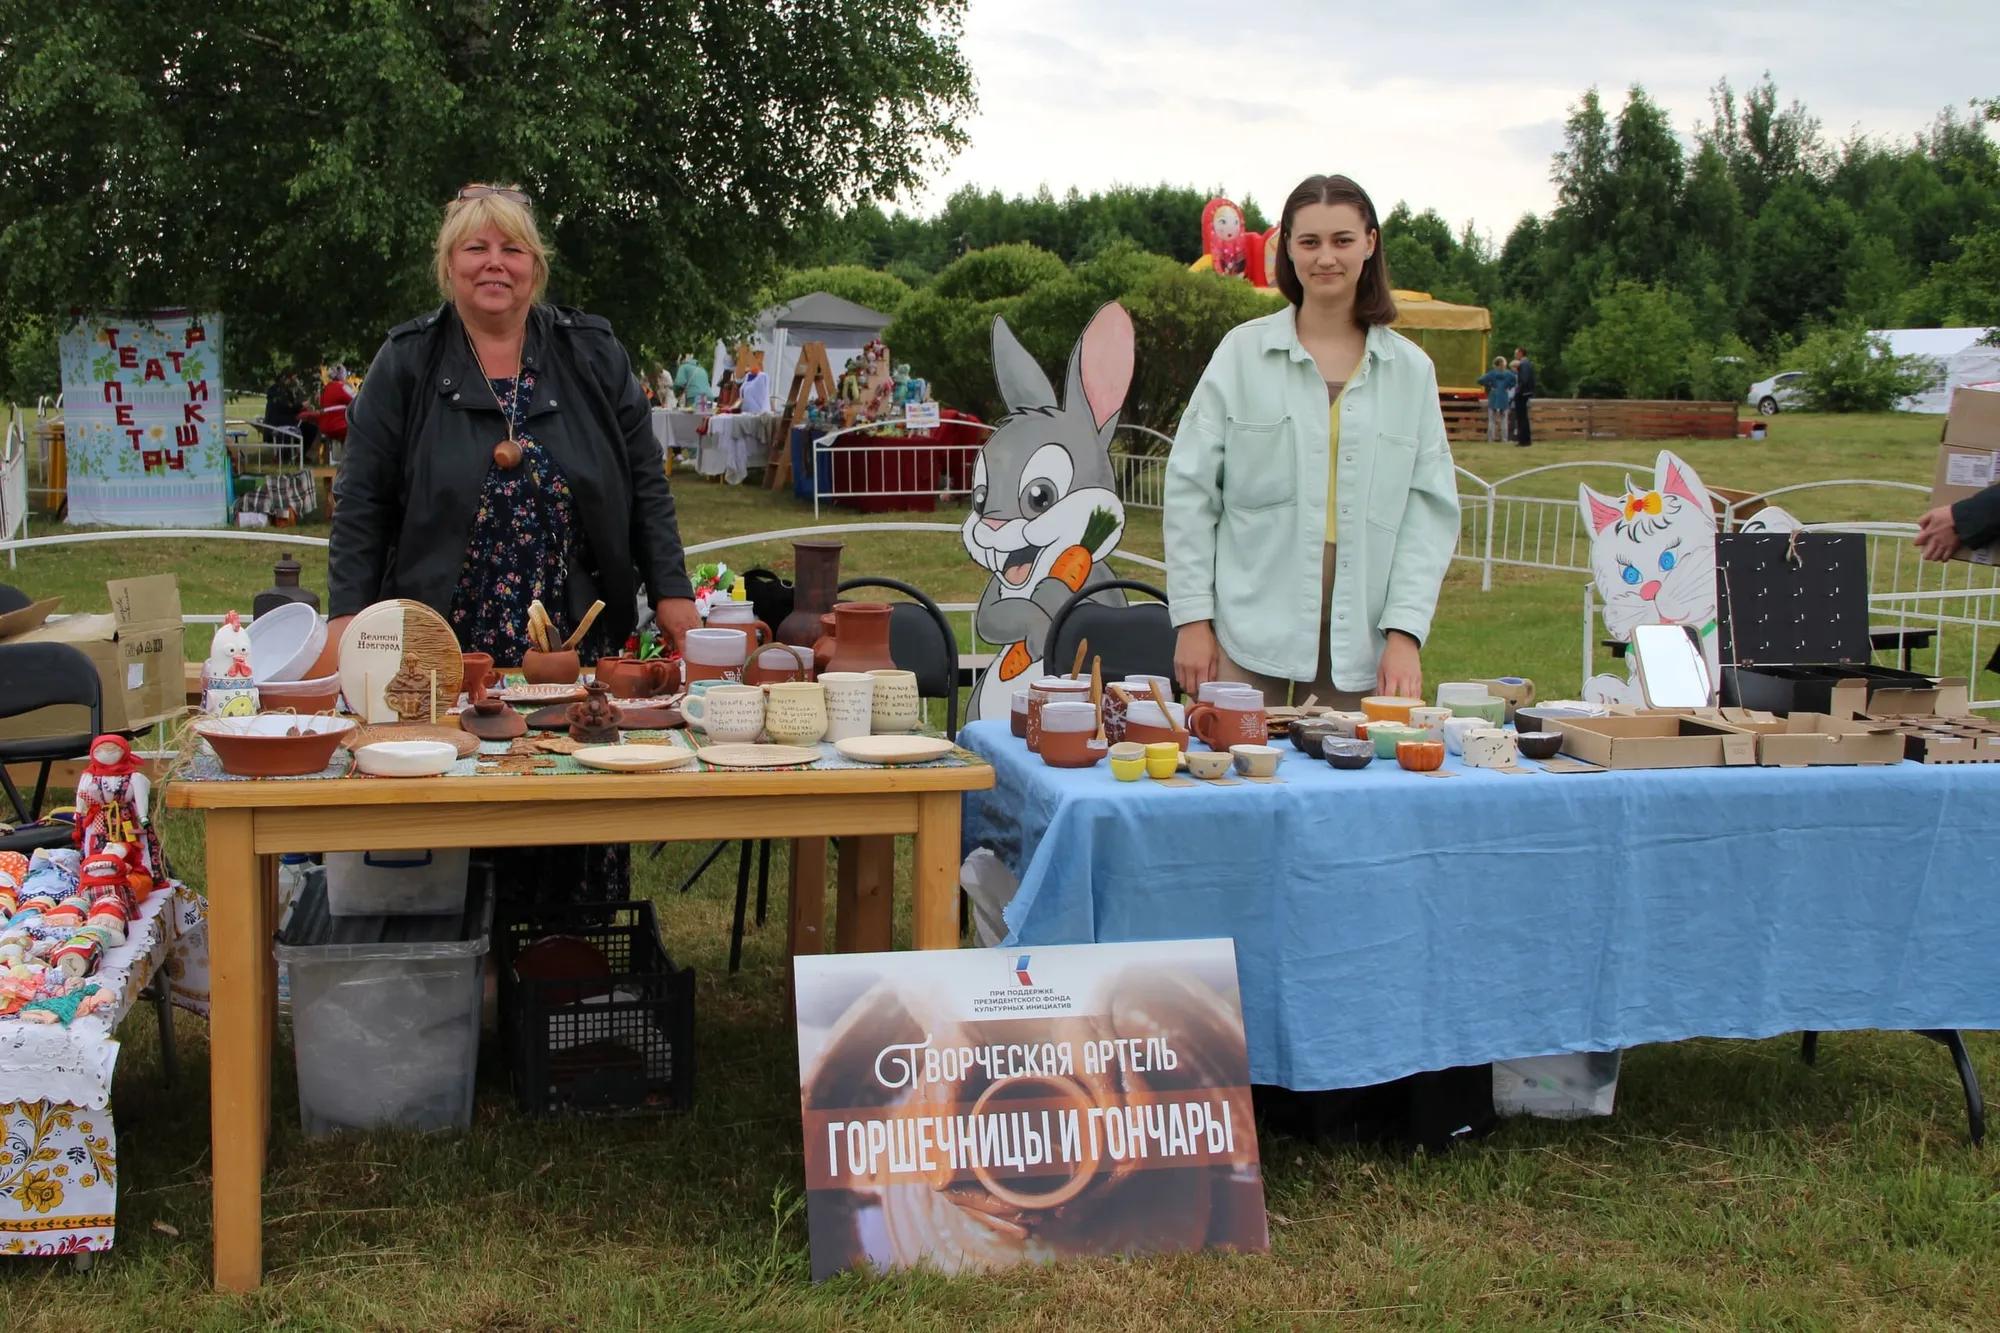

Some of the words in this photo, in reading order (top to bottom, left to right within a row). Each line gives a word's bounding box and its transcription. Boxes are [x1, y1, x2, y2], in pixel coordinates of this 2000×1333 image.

[105, 327, 206, 381] ТЕАТР
[104, 379, 208, 472] ПЕТРУШКИ
[360, 631, 399, 641] Великий
[357, 640, 400, 652] Новгород
[1007, 988, 1054, 996] ПОДДЕРЖКЕ
[973, 997, 1042, 1005] ПРЕЗИДЕНТСКОГО
[974, 1005, 1025, 1013] КУЛЬТУРНЫХ
[874, 1033, 1074, 1090] ТВОРЧЕСКАЯ
[1083, 1037, 1178, 1075] АРТЕЛЬ
[828, 1110, 1053, 1177] ГОРШЕЧНИЦЫ
[1058, 1109, 1082, 1162] И
[1088, 1100, 1235, 1161] ГОНЧАРЫ
